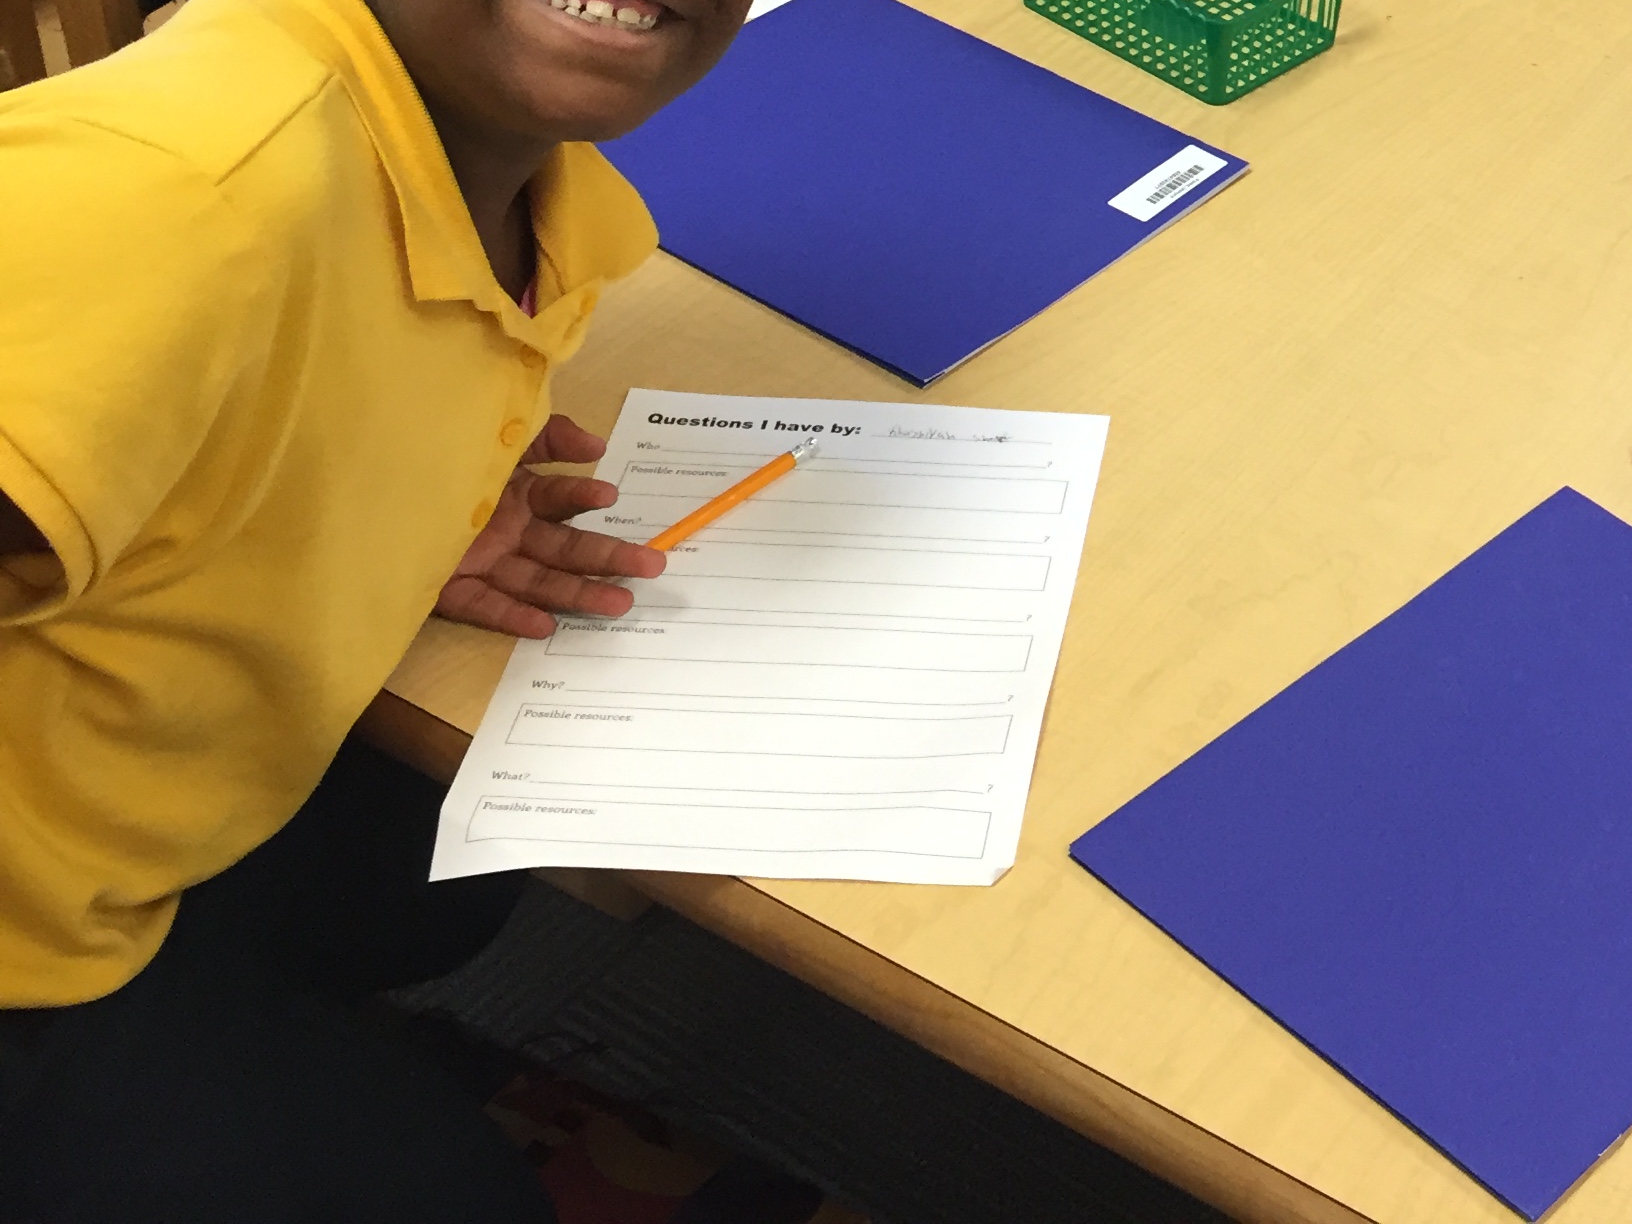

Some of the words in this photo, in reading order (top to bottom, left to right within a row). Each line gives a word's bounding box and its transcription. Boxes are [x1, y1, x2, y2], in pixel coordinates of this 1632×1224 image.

[647, 412, 754, 431] Questions
[760, 419, 769, 431] I
[773, 420, 825, 434] have
[830, 423, 862, 436] by:
[630, 465, 673, 476] Possible
[603, 515, 642, 525] When?
[561, 622, 608, 633] Possible
[531, 679, 566, 691] Why?
[523, 708, 572, 720] Possible
[491, 770, 532, 781] What?
[482, 801, 533, 812] Possible
